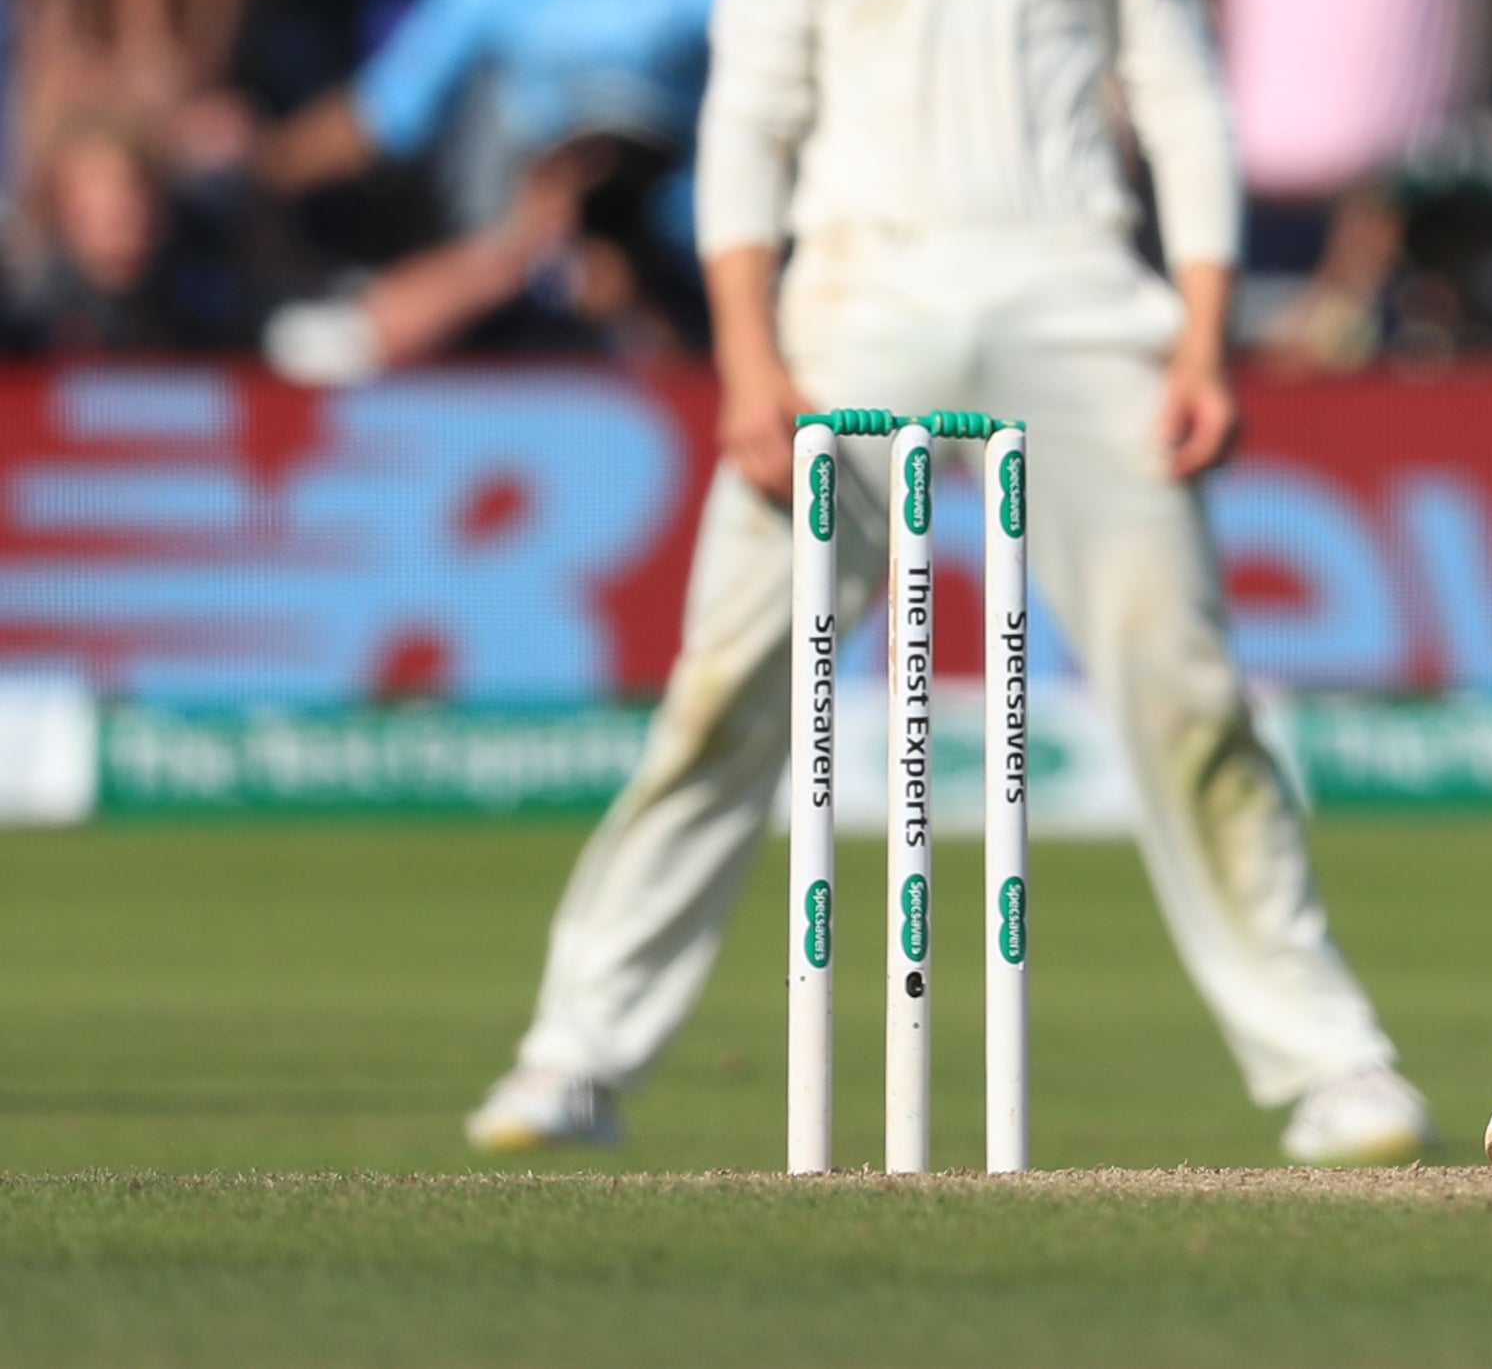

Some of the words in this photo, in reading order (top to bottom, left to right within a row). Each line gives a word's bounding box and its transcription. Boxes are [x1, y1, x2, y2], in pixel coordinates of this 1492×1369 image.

[818, 460, 832, 535] Specsavers
[913, 452, 928, 528] Specsavers
[1008, 457, 1023, 532] Specsavers
[907, 561, 931, 626] The
[907, 633, 931, 707] Test
[1001, 611, 1027, 804] Specsavers
[809, 614, 836, 808] Specsavers
[900, 716, 930, 847] Experts
[812, 887, 828, 961] Specsavers
[907, 881, 925, 955] Specsavers
[1005, 883, 1022, 957] Specsavers
